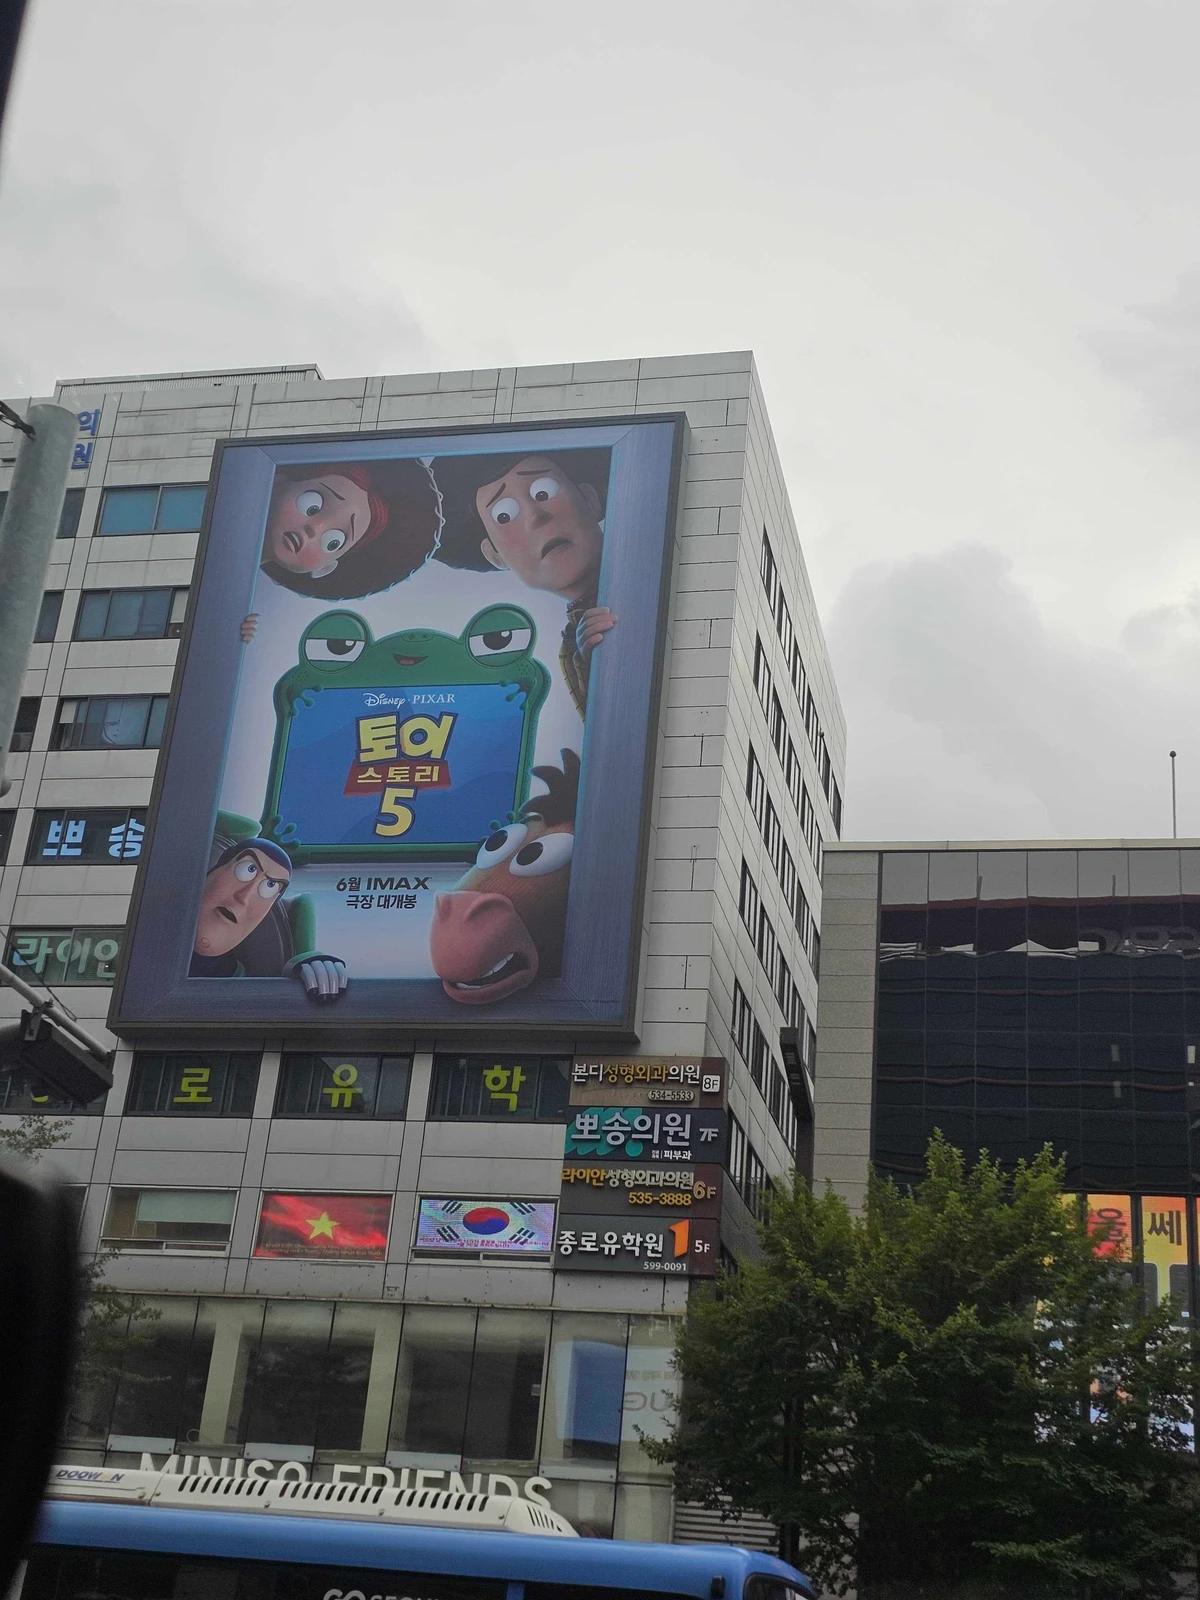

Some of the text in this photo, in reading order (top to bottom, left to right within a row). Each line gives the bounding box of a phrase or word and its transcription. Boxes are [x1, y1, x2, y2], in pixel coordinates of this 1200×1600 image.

[412, 693, 456, 705] PIXAR
[355, 711, 459, 765] 토이
[356, 765, 440, 783] 스토리
[373, 785, 418, 838] 5
[336, 876, 430, 892] 6월 IMAX
[346, 893, 417, 910] 극장 대개봉
[703, 1076, 720, 1091] 8F
[650, 1090, 692, 1101] 534-5533
[571, 1112, 719, 1147] 뽀송의원 7F
[663, 1150, 692, 1160] 피부과
[693, 1180, 716, 1200] 6F
[628, 1191, 692, 1206] 535-3888
[557, 1230, 664, 1258] 종로유학원
[694, 1239, 711, 1253] 5F
[643, 1261, 687, 1272] 599-0091
[55, 1469, 125, 1482] DOOWN
